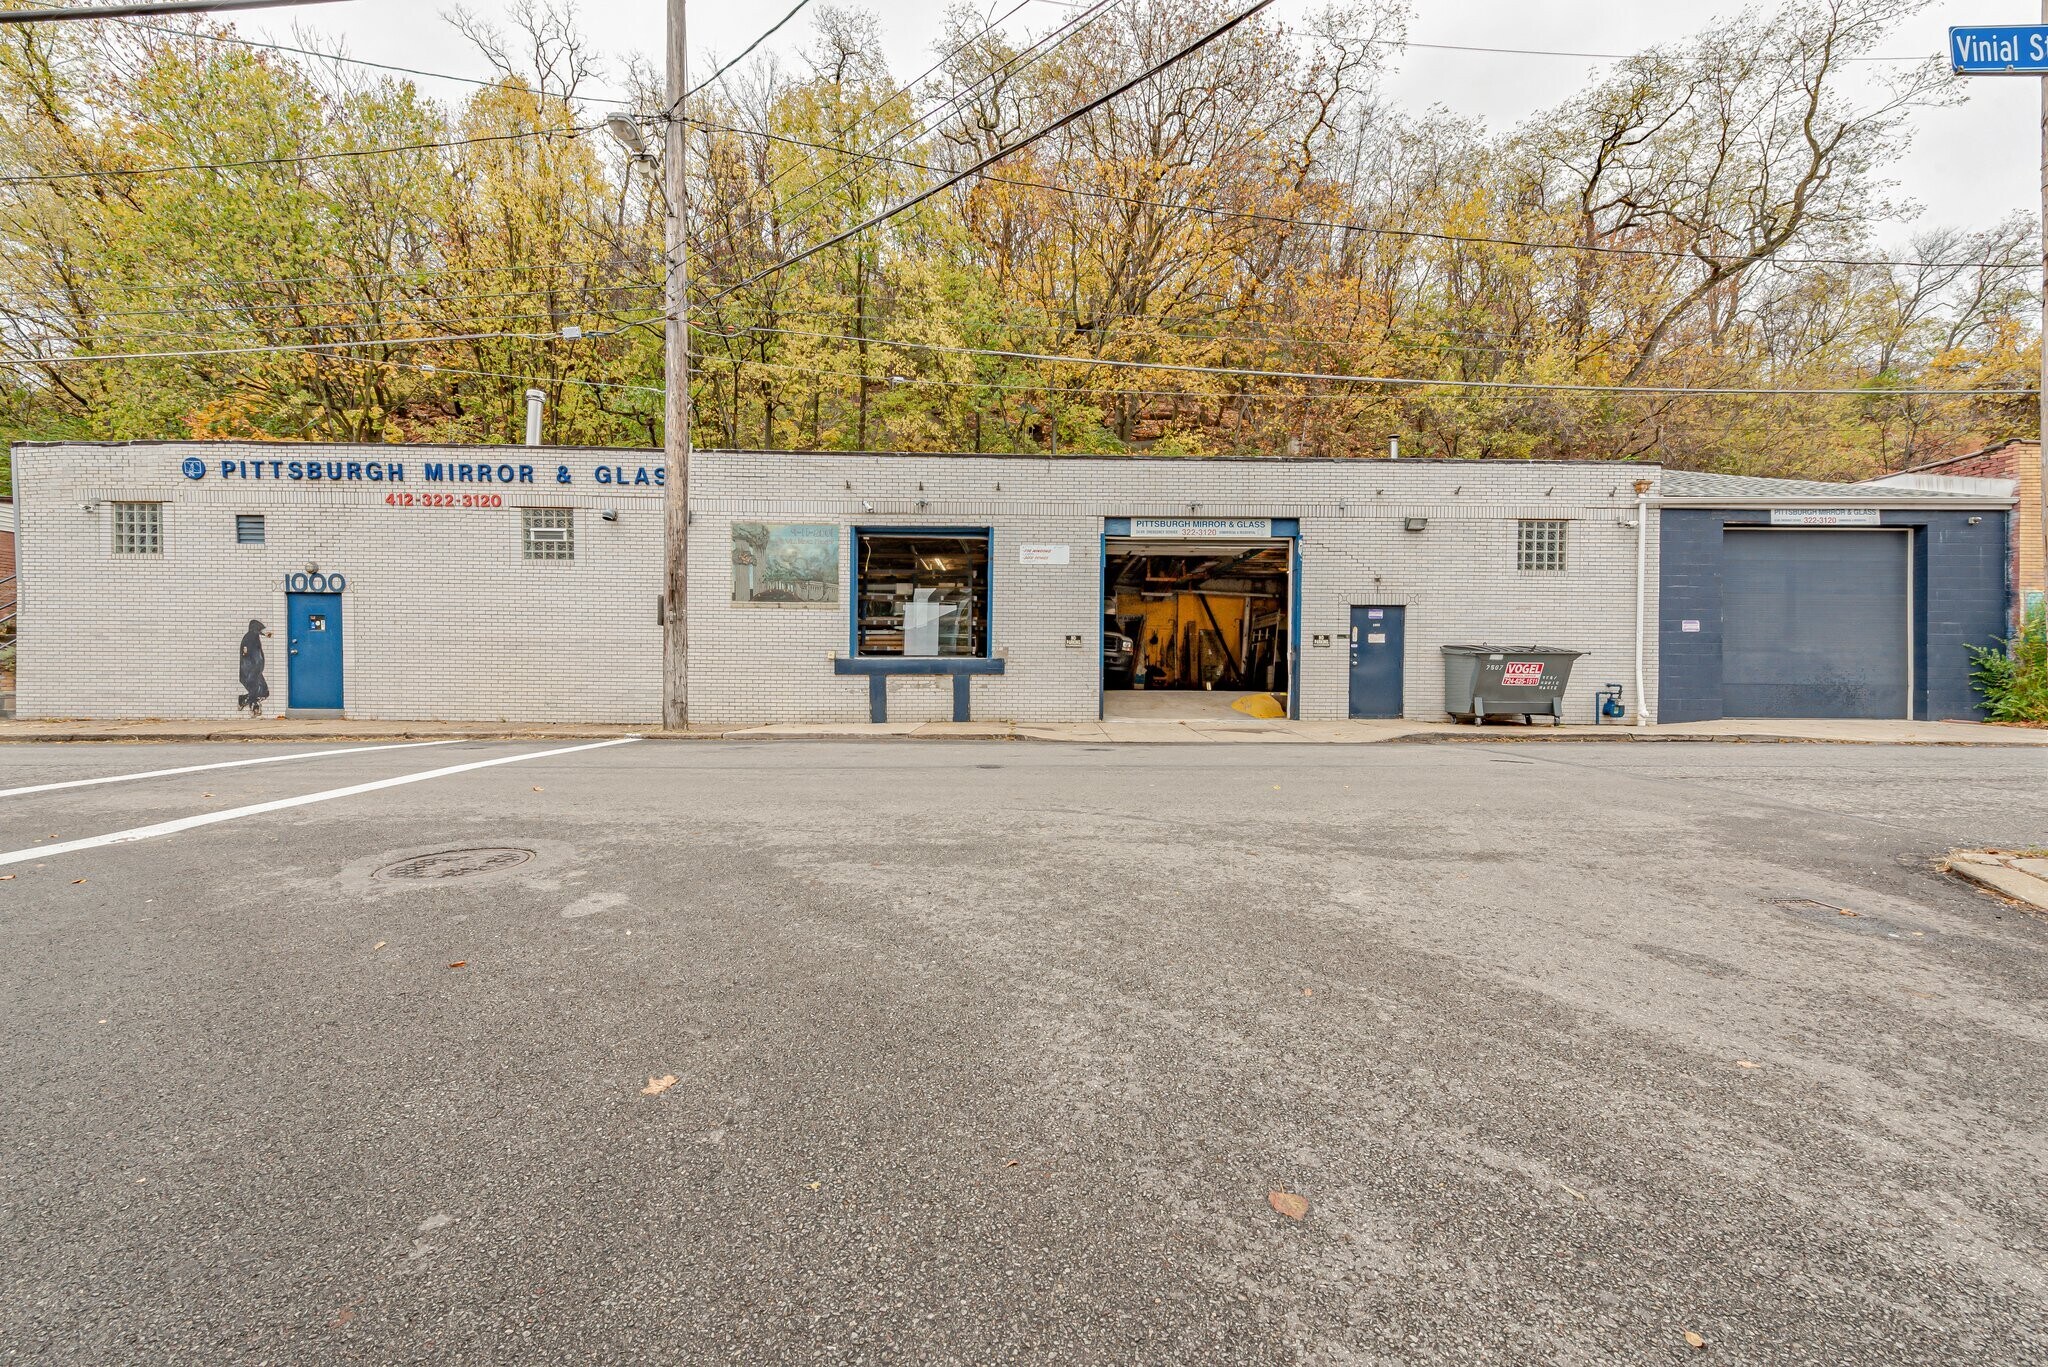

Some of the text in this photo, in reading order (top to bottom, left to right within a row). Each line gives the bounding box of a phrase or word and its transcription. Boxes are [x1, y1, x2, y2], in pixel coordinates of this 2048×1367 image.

[1956, 34, 2019, 62] Vinial
[221, 460, 665, 486] PITTSBURGH MIRROR & GLAS
[385, 493, 502, 507] 412-322-3120
[1136, 520, 1266, 528] PITTSBURGH MIRROR & GLASS
[285, 573, 346, 593] 1000
[1508, 664, 1541, 674] VOGEL
